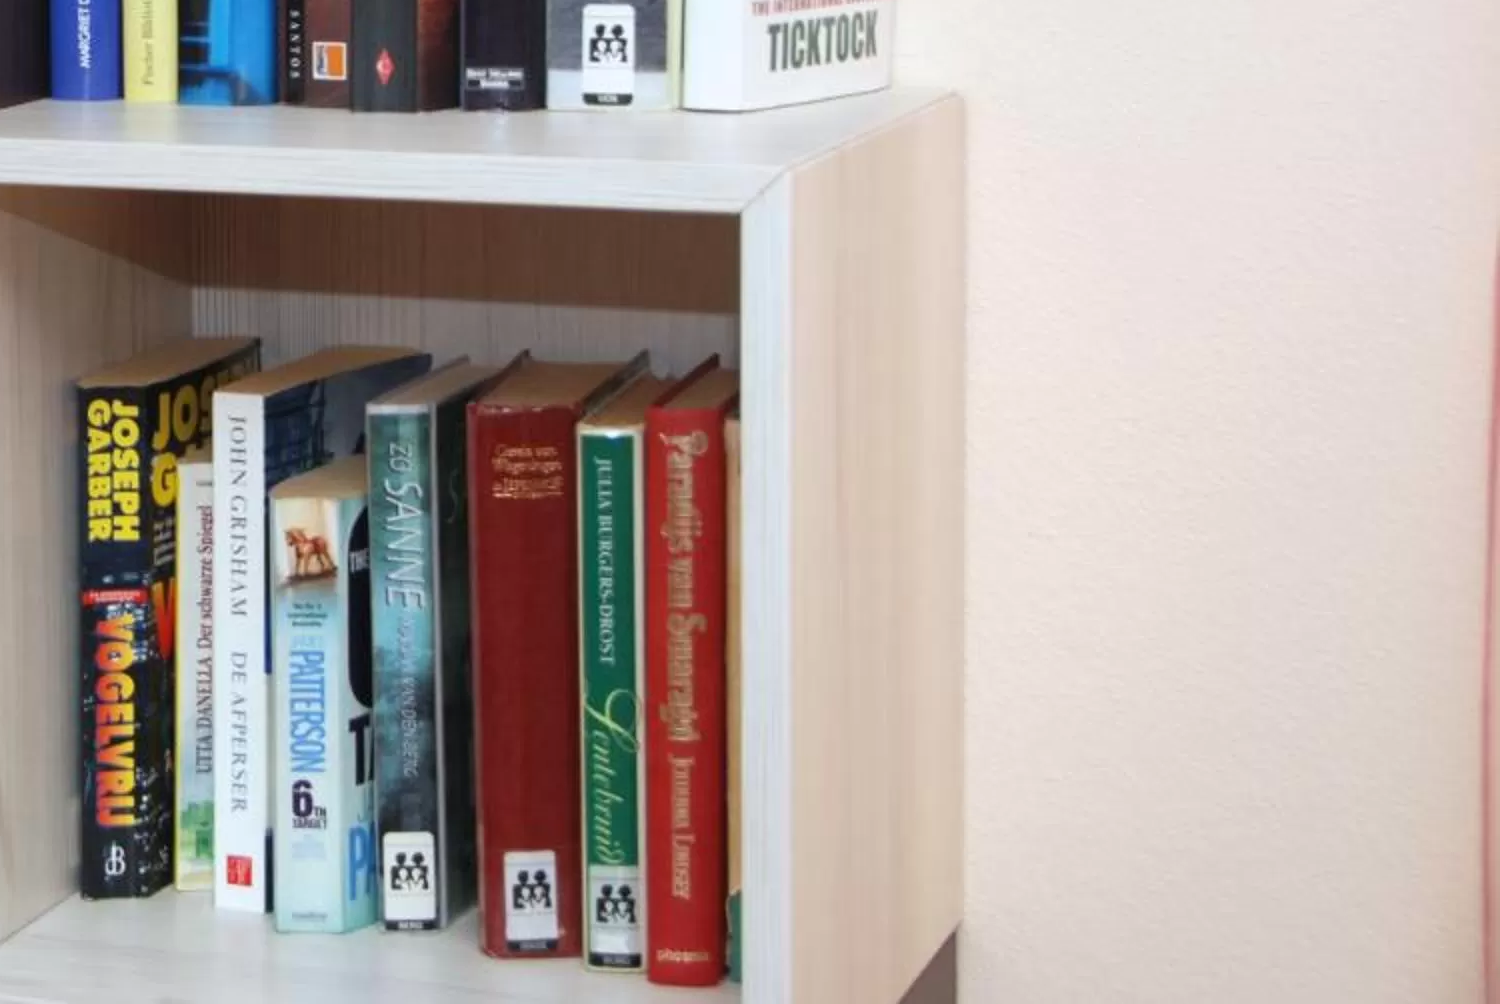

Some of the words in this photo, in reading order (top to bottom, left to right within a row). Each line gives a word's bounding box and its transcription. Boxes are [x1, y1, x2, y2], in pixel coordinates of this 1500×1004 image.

[289, 8, 301, 79] SANTOS
[768, 10, 878, 72] TICKTOCK
[87, 399, 112, 542] GARBER
[112, 399, 140, 541] JOSEPH
[228, 415, 247, 486] JOHN
[388, 441, 412, 473] ZO
[594, 456, 613, 509] JULIA
[195, 505, 213, 554] Spiegel
[229, 495, 248, 617] GRISHAM
[384, 477, 426, 610] SANNE
[196, 558, 212, 622] schwarze
[598, 514, 616, 667] BURGERS-DROST
[196, 624, 212, 649] Der
[230, 651, 248, 685] DE
[96, 614, 137, 827] VOGELVRIJ
[196, 656, 212, 729] DANELLA
[289, 650, 325, 773] PATTERSON
[196, 733, 212, 773] UTTA
[230, 692, 248, 813] AFPERSER
[584, 688, 640, 864] Lentebruid
